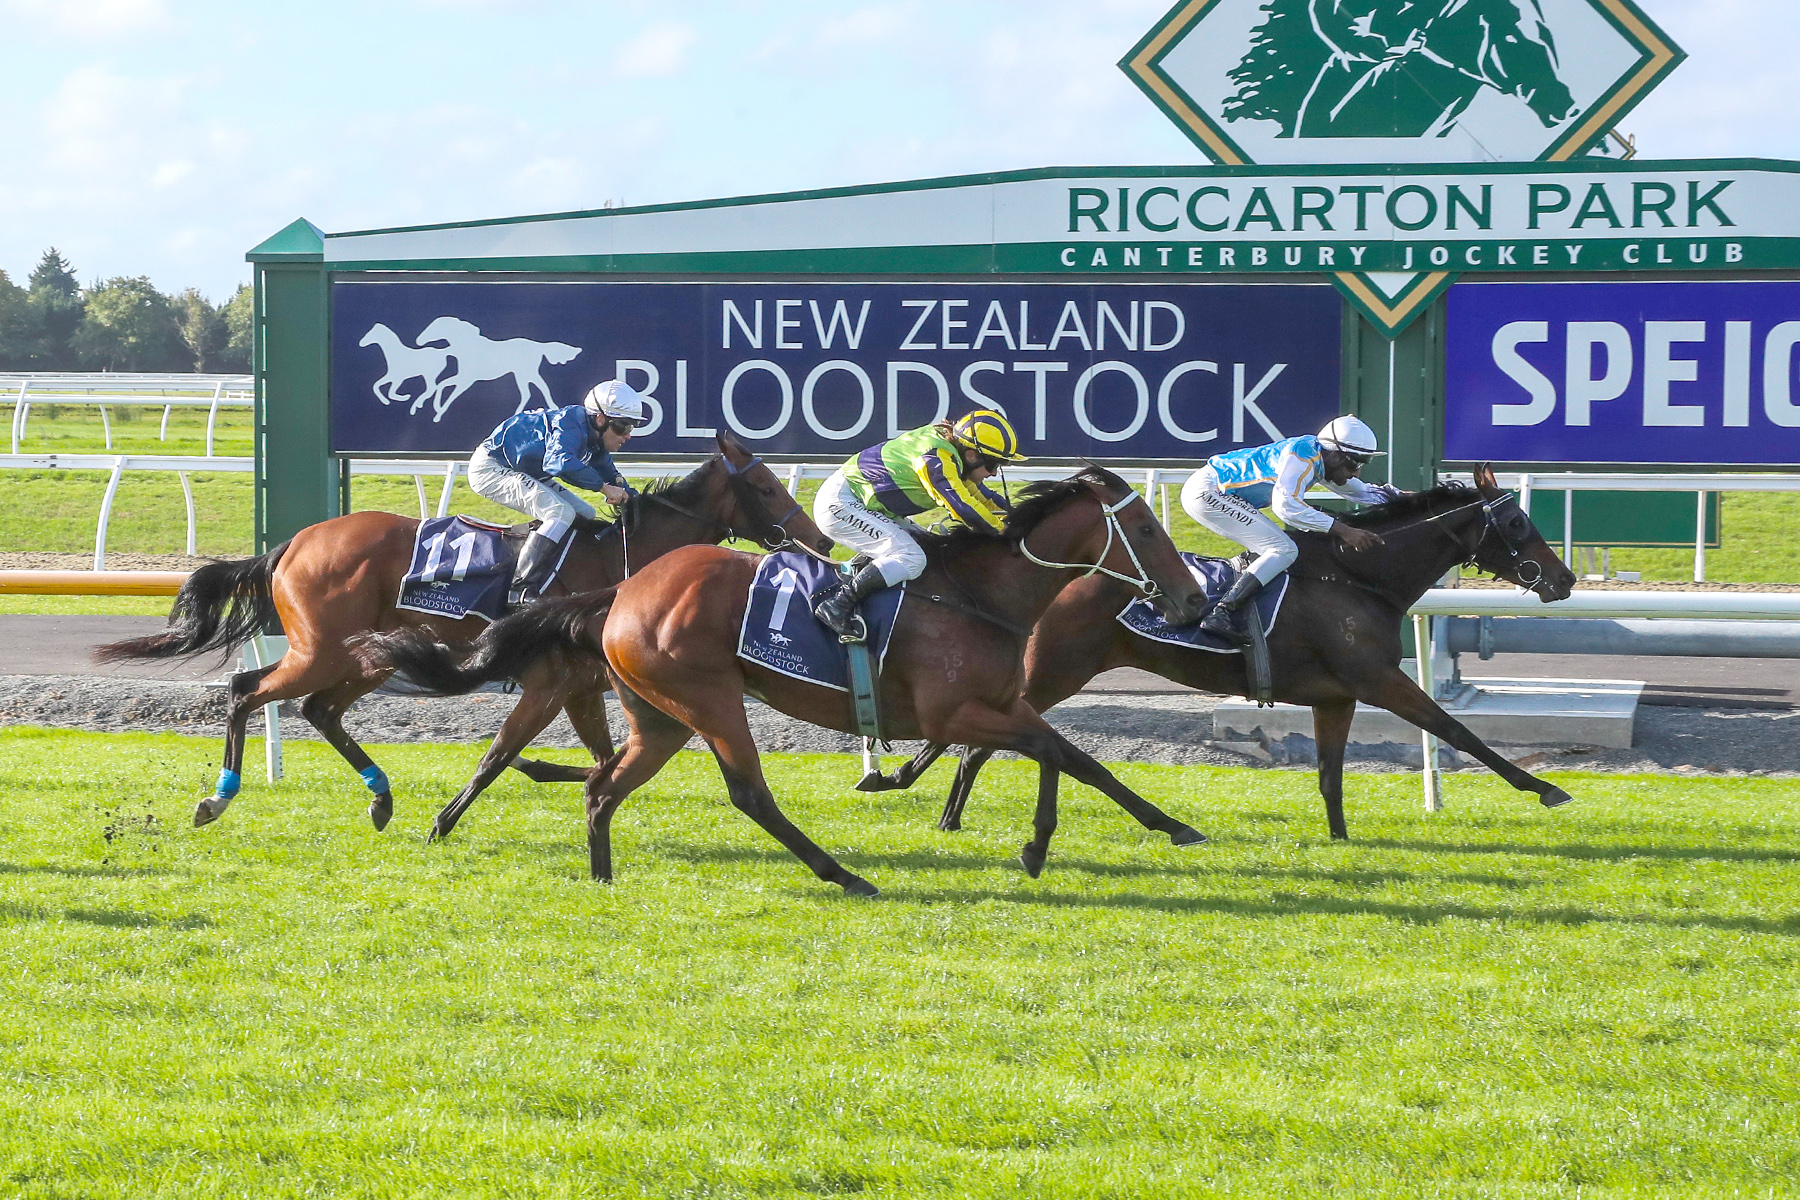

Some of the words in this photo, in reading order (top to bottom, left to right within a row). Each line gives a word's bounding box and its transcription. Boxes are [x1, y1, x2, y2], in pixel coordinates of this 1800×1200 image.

[1067, 184, 1492, 232] RICCARTON
[1527, 180, 1736, 230] PARK
[1060, 246, 1367, 267] CANTERBURY
[1402, 245, 1583, 270] JOCKEY
[1622, 243, 1744, 264] CLUB
[722, 299, 871, 350] NEW
[899, 299, 1186, 352] ZEALAND
[615, 358, 1288, 443] BLOODSTOCK
[421, 531, 476, 582] 11
[403, 595, 466, 614] BLOODSTOCK
[413, 590, 428, 598] NEW
[429, 592, 460, 604] ZEALAND
[768, 567, 798, 631] 1
[743, 644, 810, 675] BLOODSTOCK
[753, 640, 768, 651] NEW
[767, 647, 803, 662] ZEALAND
